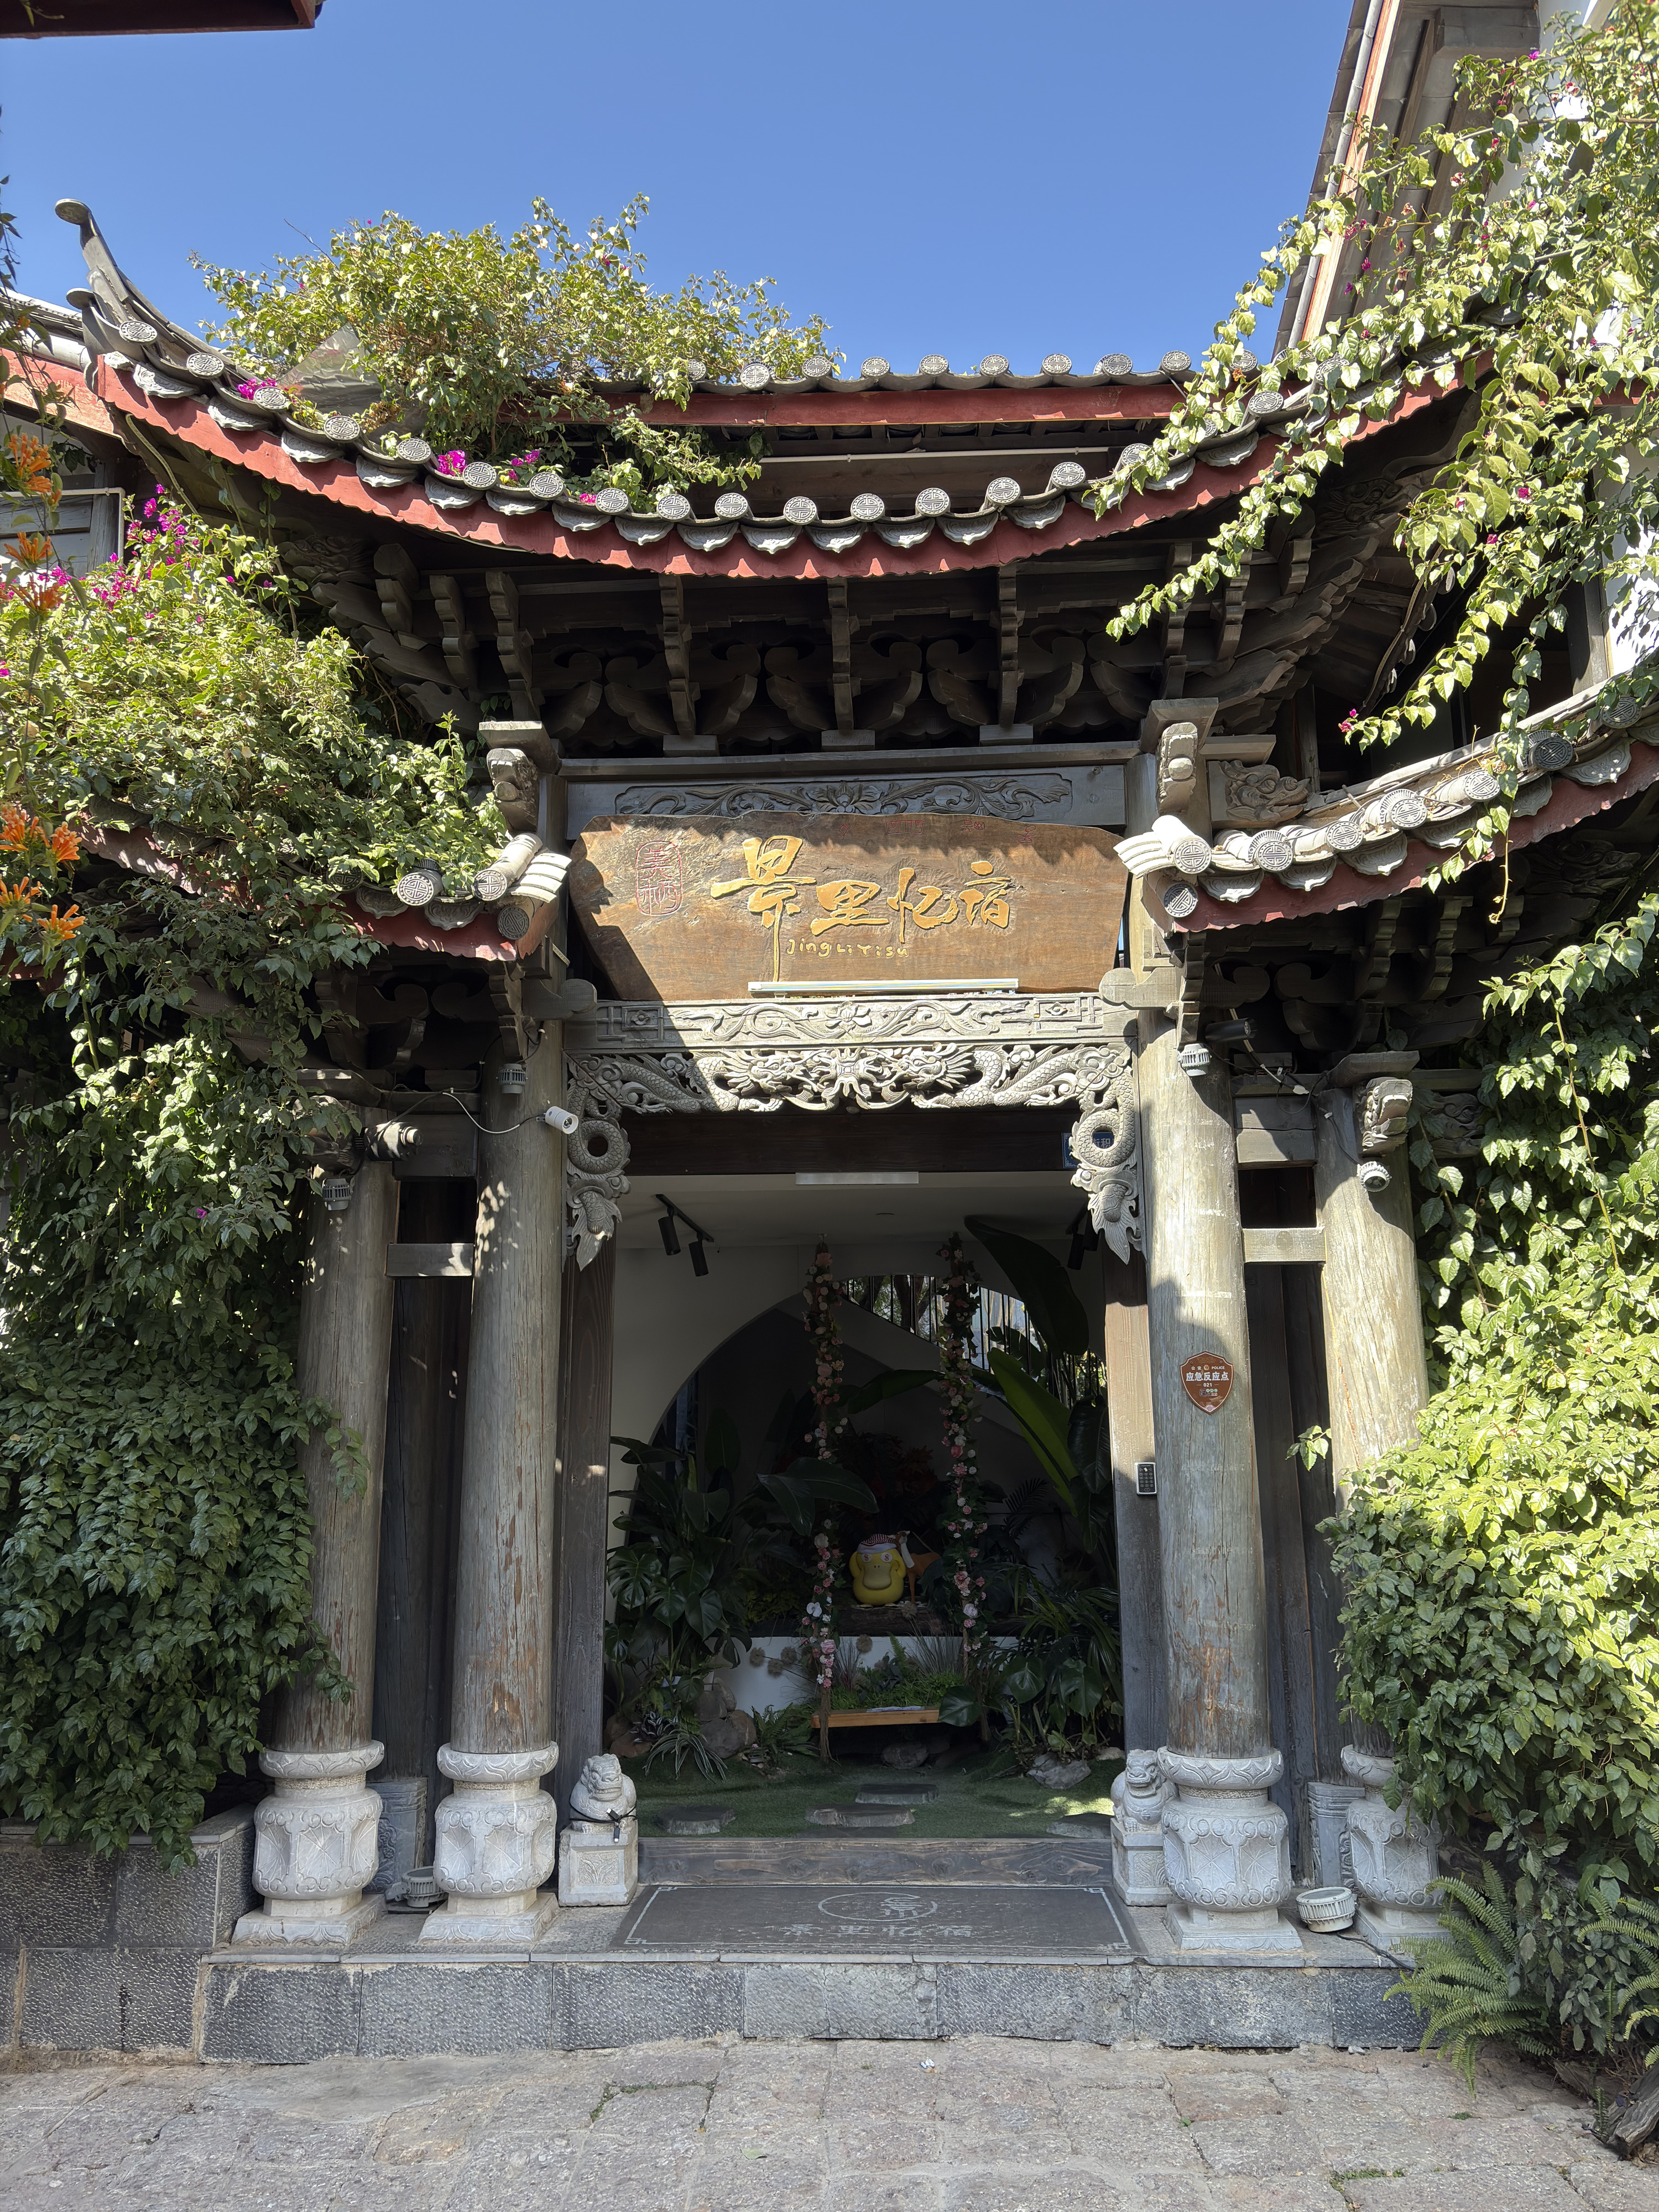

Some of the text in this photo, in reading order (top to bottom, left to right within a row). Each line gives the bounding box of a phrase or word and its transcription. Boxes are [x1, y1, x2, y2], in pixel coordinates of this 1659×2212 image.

[711, 835, 1011, 982] 景里忆宿
[1186, 1371, 1229, 1381] 应急反应点
